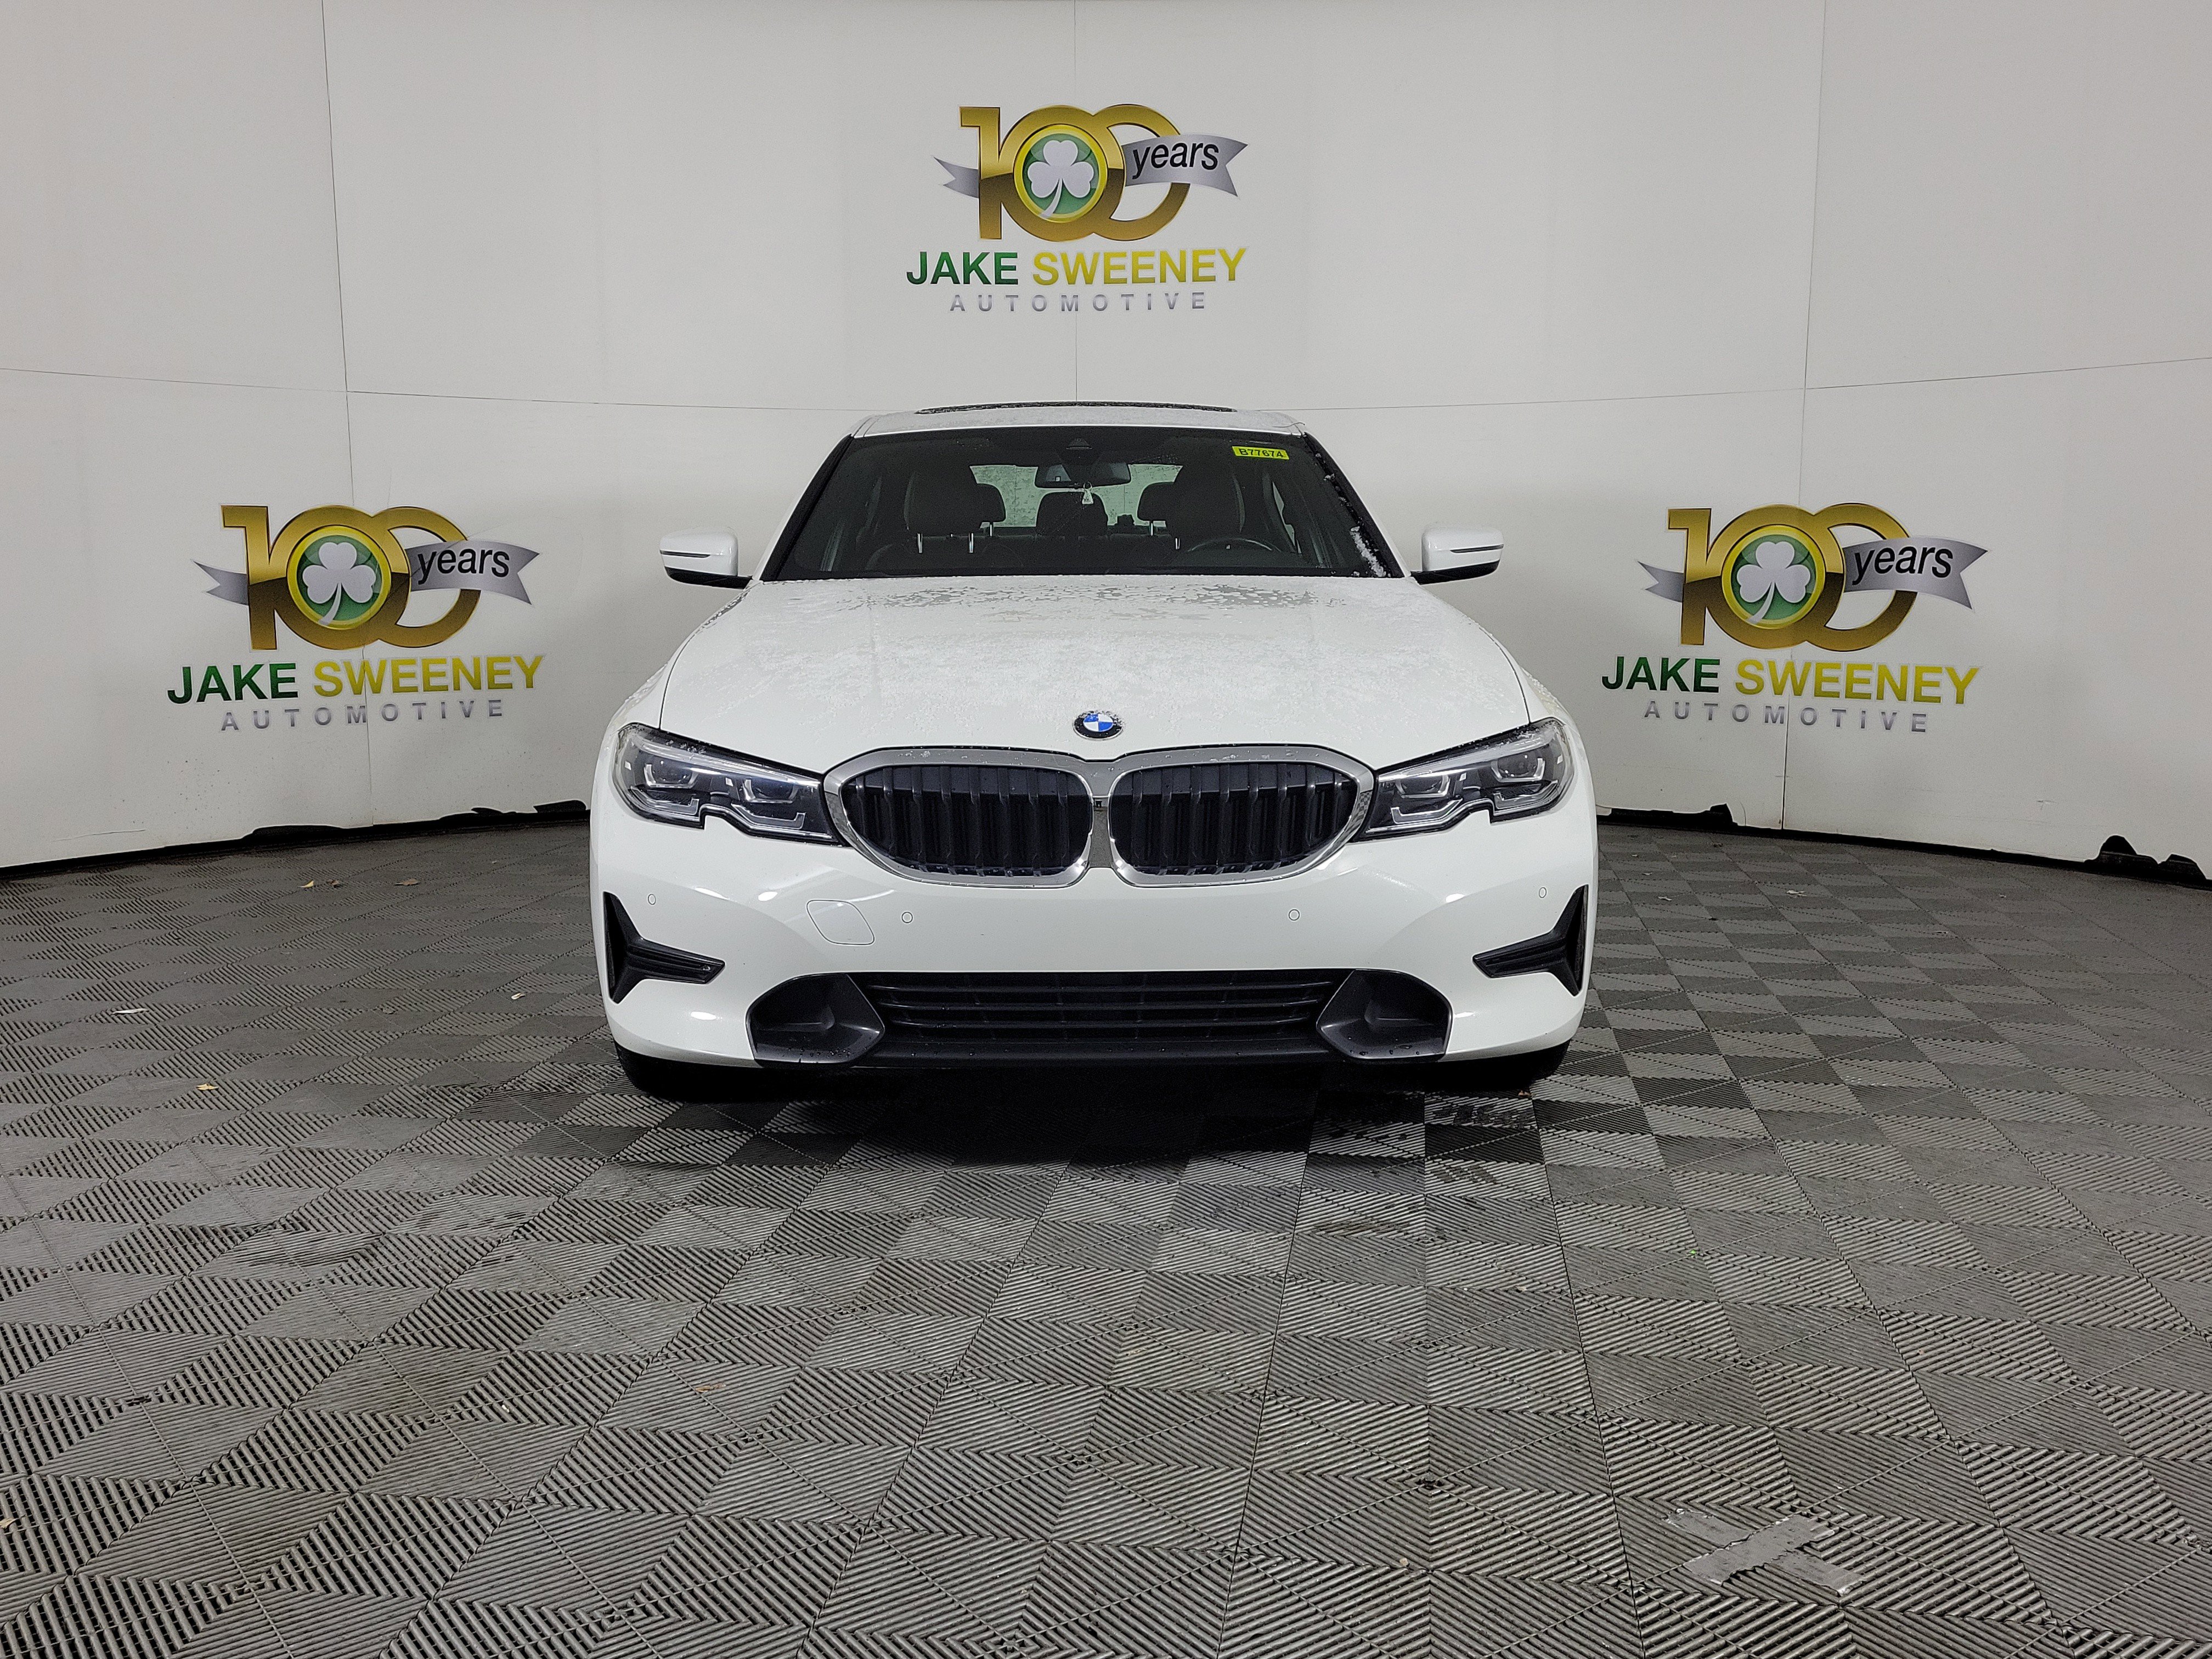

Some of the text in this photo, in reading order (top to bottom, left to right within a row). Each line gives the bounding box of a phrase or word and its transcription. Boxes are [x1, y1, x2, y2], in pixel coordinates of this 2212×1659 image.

[959, 104, 1220, 242] 100 years
[906, 247, 1247, 285] JAKE SWEENEY
[950, 292, 1205, 312] AUTOMOTIVE
[221, 505, 510, 651] 100 years
[1668, 503, 1953, 652] 100 years
[167, 655, 544, 704] JAKE SWEENEY
[1601, 656, 1980, 704] JAKE SWEENEY
[221, 699, 503, 731] AUTOMOTIVE
[1644, 700, 1927, 732] AUTOMOTIVE
